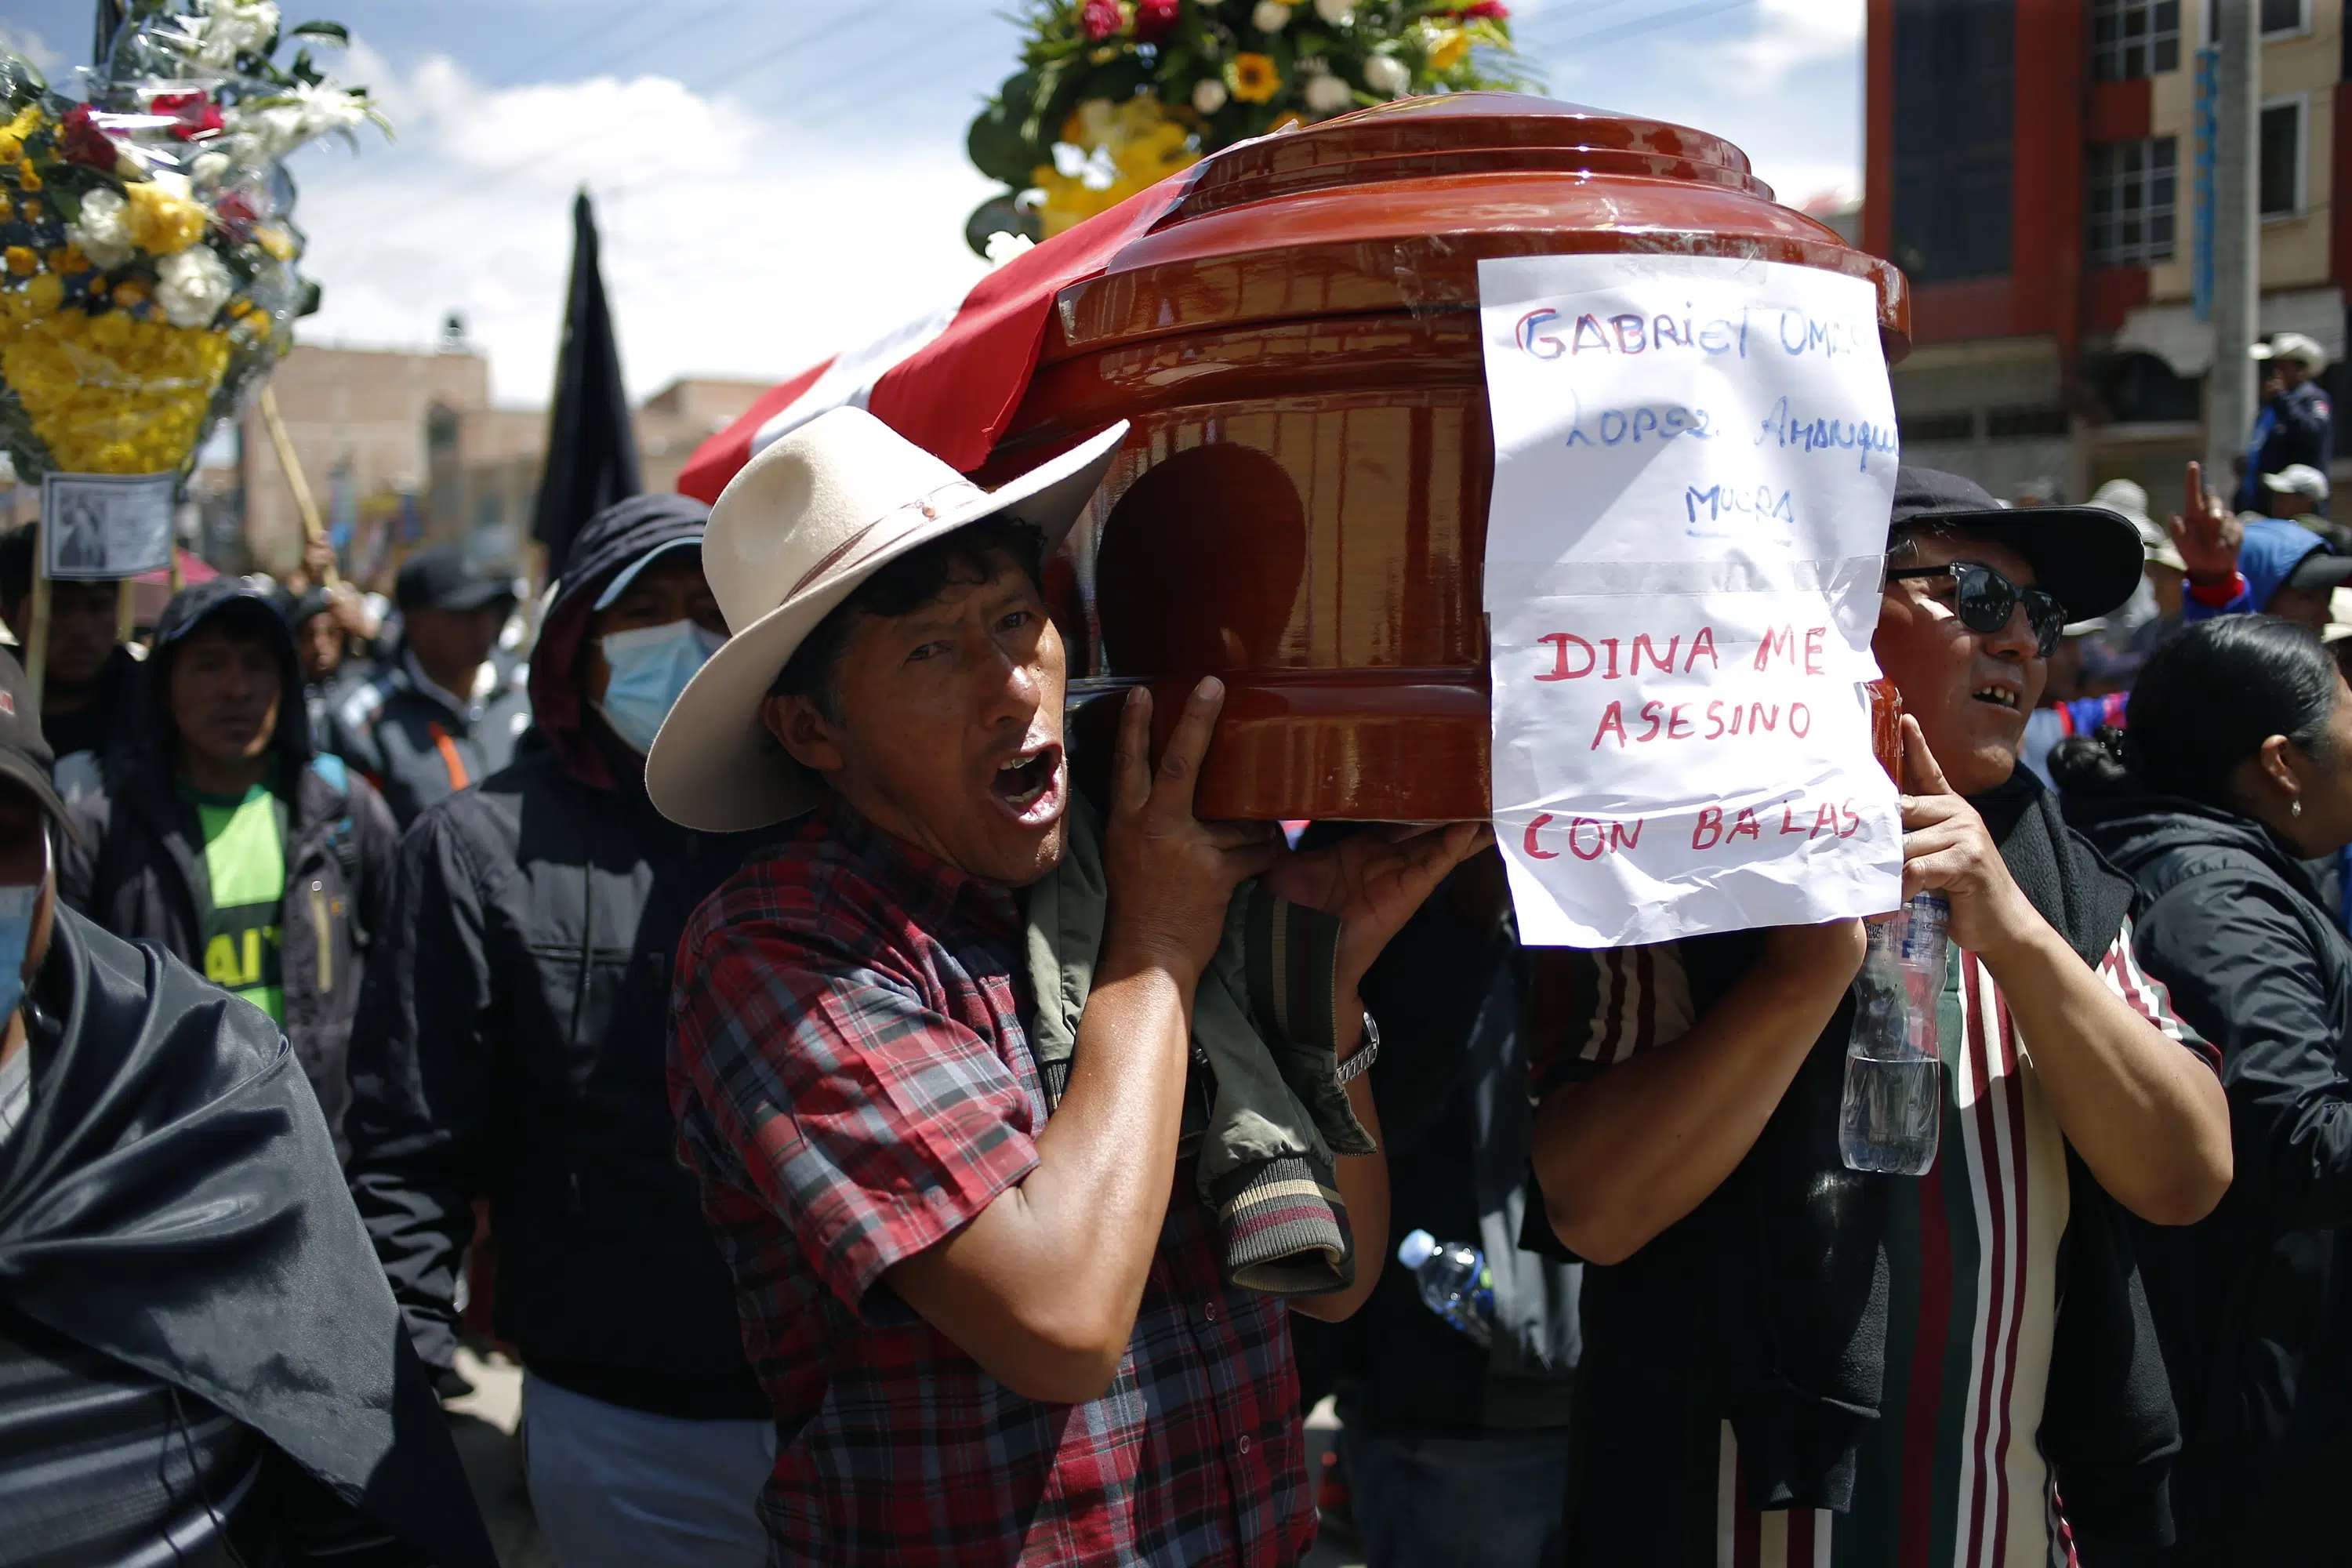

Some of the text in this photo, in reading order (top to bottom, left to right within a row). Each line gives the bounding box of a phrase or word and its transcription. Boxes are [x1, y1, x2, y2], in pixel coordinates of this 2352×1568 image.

[1534, 626, 1826, 681] DINA ME
[1591, 700, 1811, 750] ASESINO
[1523, 799, 1860, 861] CON BALAS
